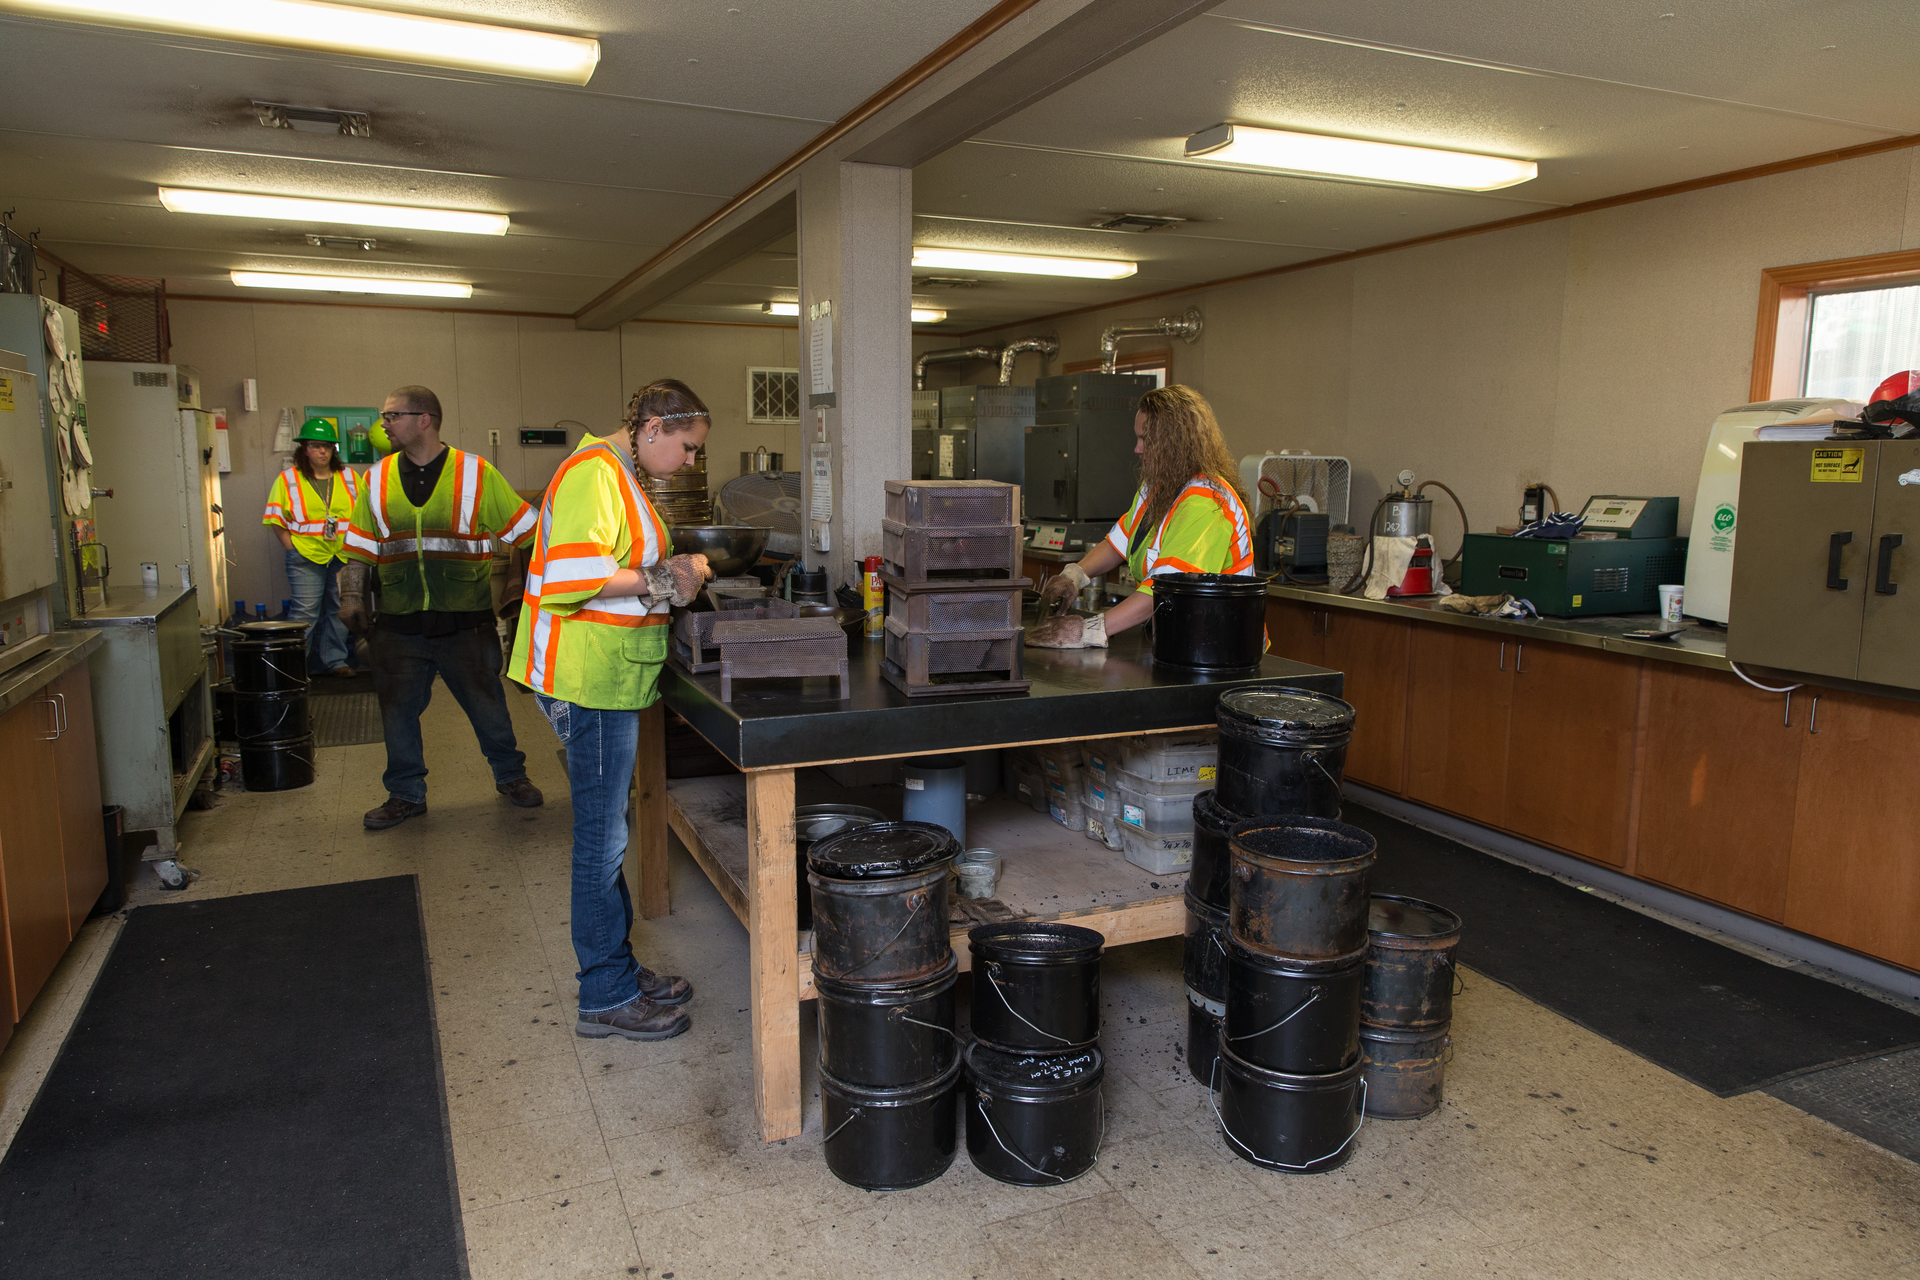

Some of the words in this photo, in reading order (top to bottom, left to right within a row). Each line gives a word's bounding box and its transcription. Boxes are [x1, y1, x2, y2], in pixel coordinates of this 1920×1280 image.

[1392, 505, 1401, 516] B
[1717, 513, 1733, 522] eco
[1167, 766, 1195, 776] LIME
[1068, 1055, 1090, 1067] Load
